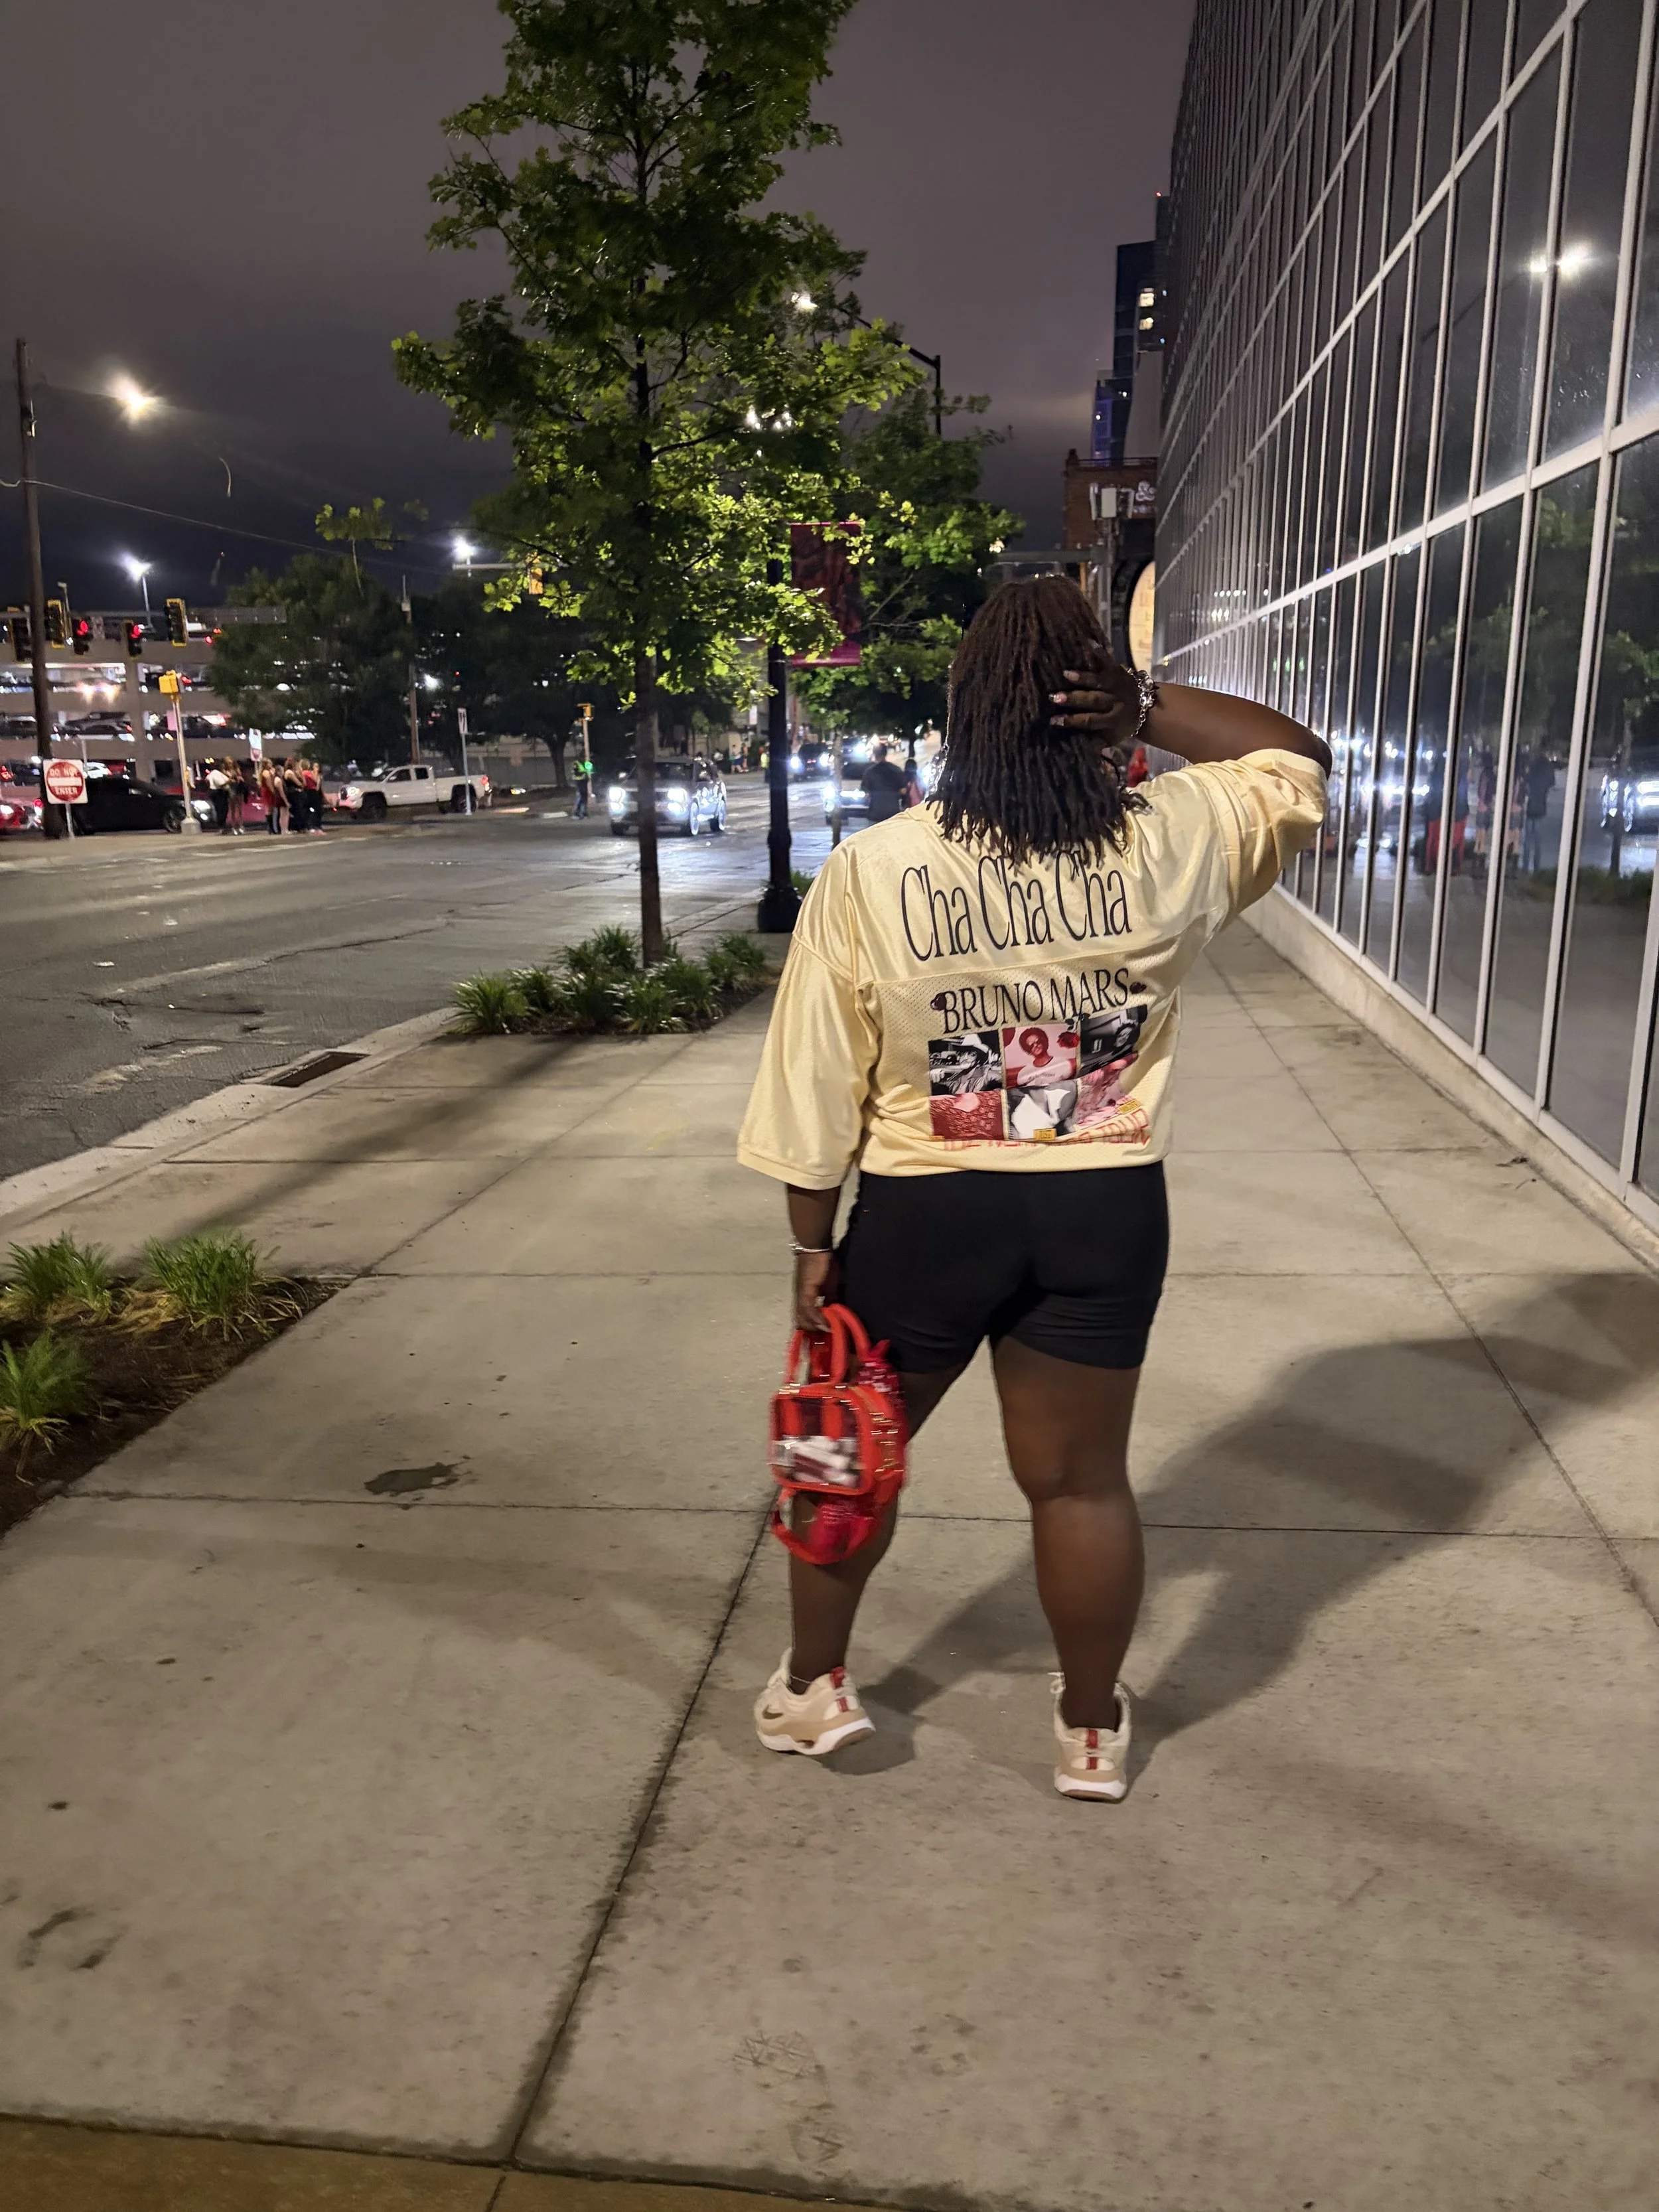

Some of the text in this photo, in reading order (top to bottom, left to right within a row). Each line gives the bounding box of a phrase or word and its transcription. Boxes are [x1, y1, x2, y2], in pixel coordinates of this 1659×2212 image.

[901, 851, 1132, 962] Cha Cha Cha
[943, 967, 1129, 1035] BRUNO MARS
